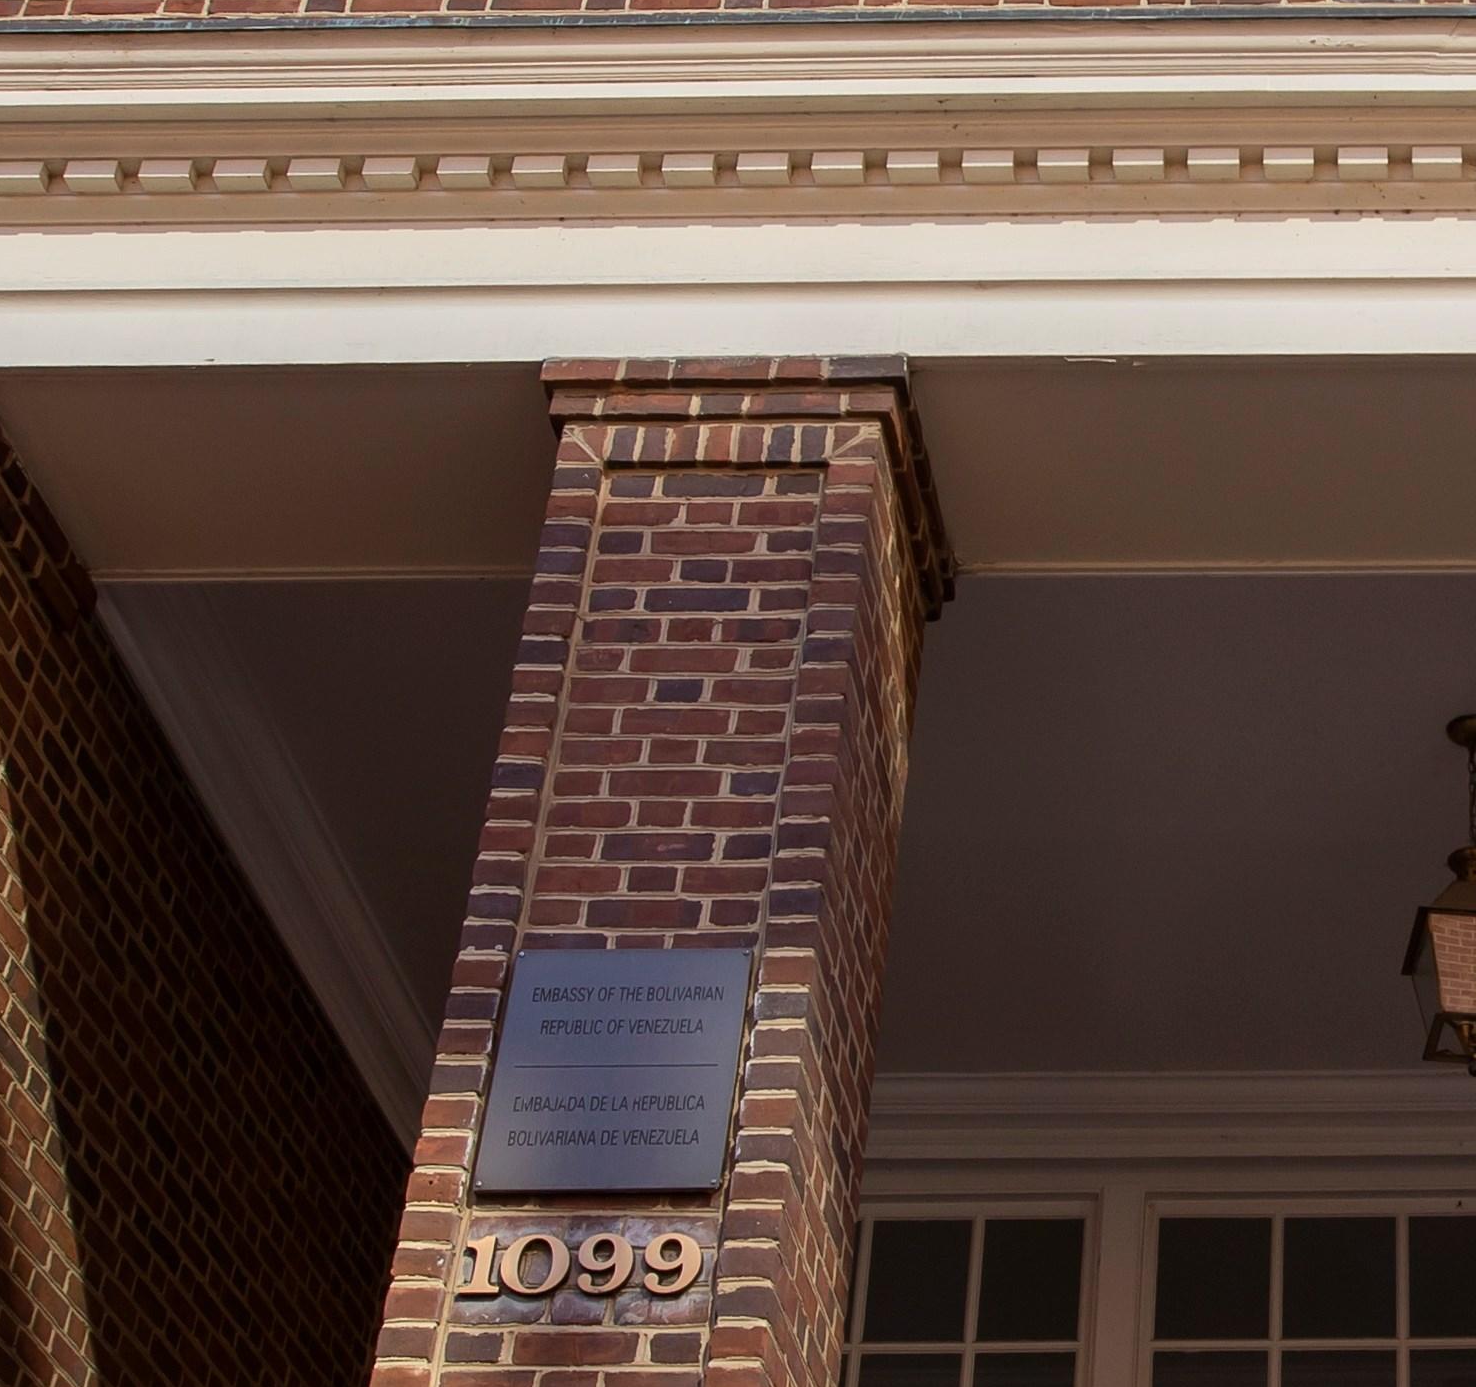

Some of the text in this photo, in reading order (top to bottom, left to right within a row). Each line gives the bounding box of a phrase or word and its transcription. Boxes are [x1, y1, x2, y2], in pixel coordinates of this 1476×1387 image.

[531, 985, 725, 1003] EMBASSY OF THE BOLIVARIAN
[539, 1018, 705, 1036] REPUBLIC OF VENEZUELA
[512, 1094, 706, 1113] EMBAJADA DE LA REPUBLICA
[507, 1128, 700, 1147] BOLIVARIANA DE VENEZUELA
[457, 1232, 703, 1296] 1099
